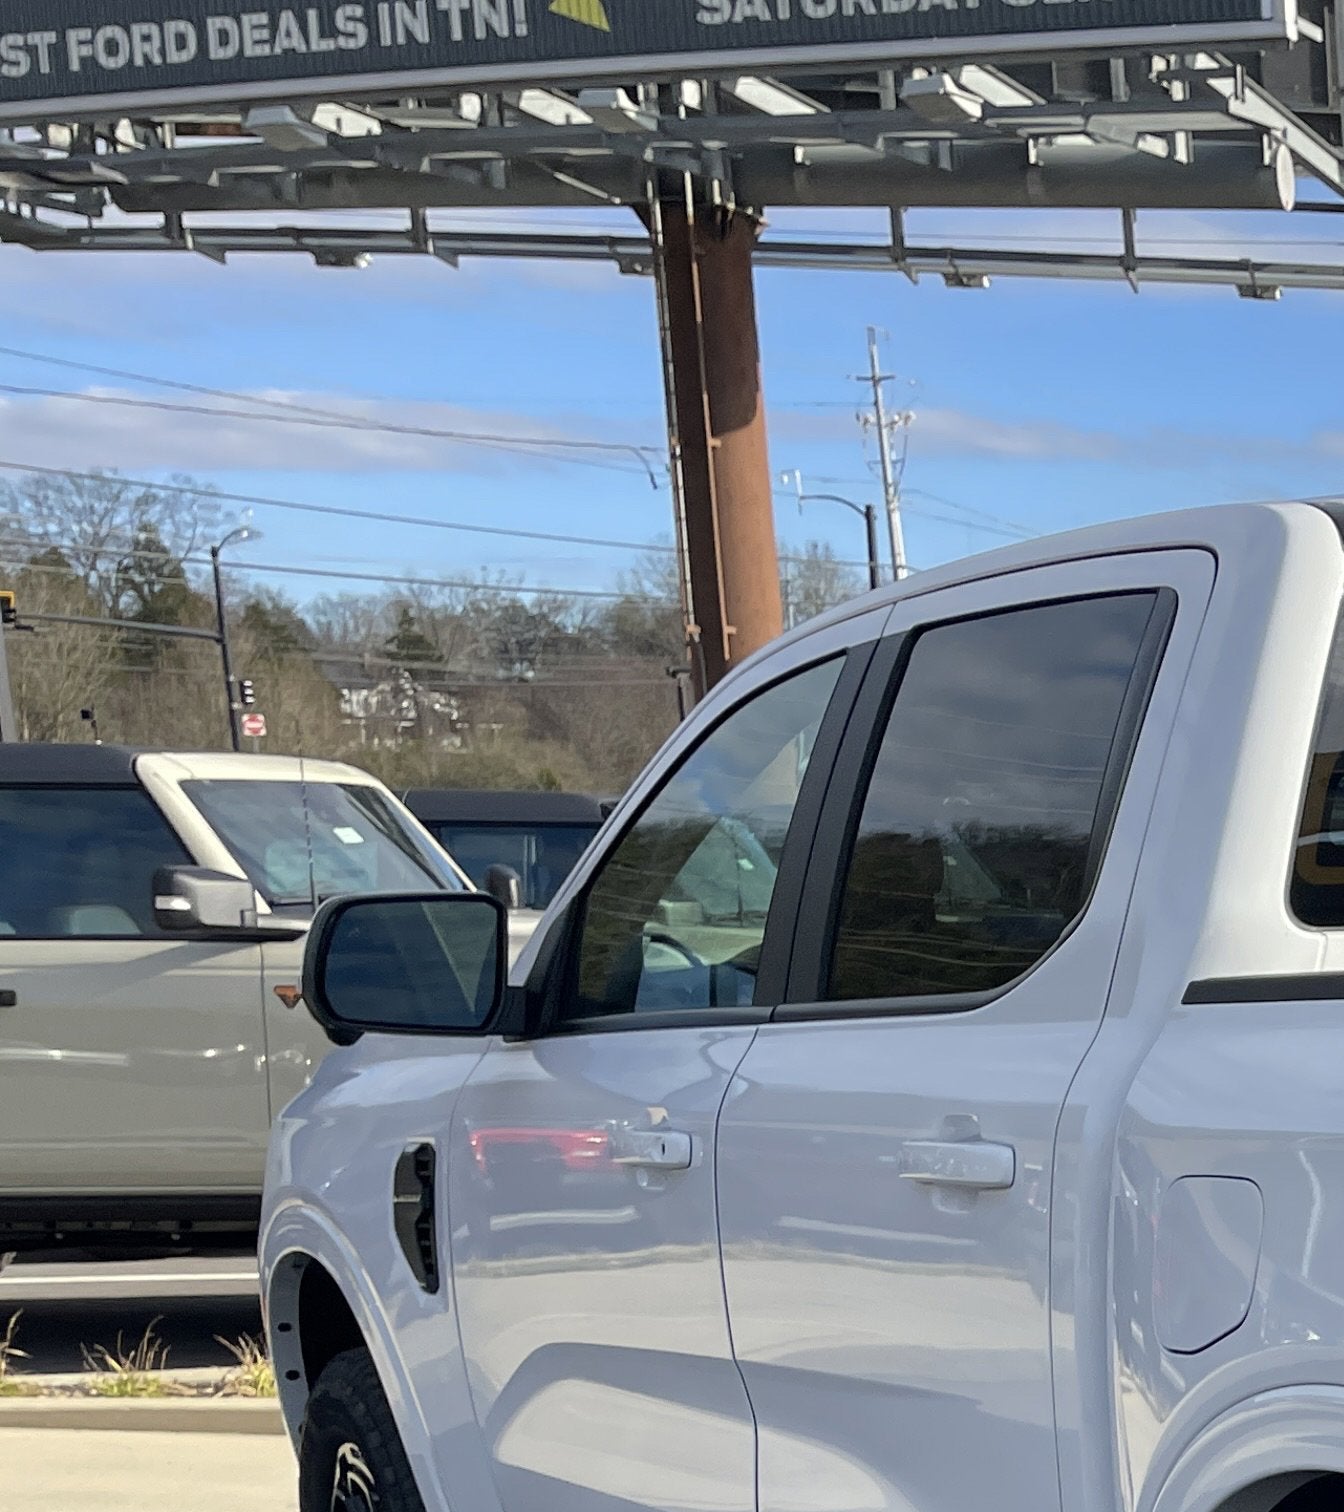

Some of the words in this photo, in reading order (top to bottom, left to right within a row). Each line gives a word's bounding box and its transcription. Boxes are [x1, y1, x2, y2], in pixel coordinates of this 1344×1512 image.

[65, 19, 199, 72] FORD
[206, 3, 369, 61] DEALS
[377, 0, 430, 47] IN
[436, 0, 529, 41] TN!
